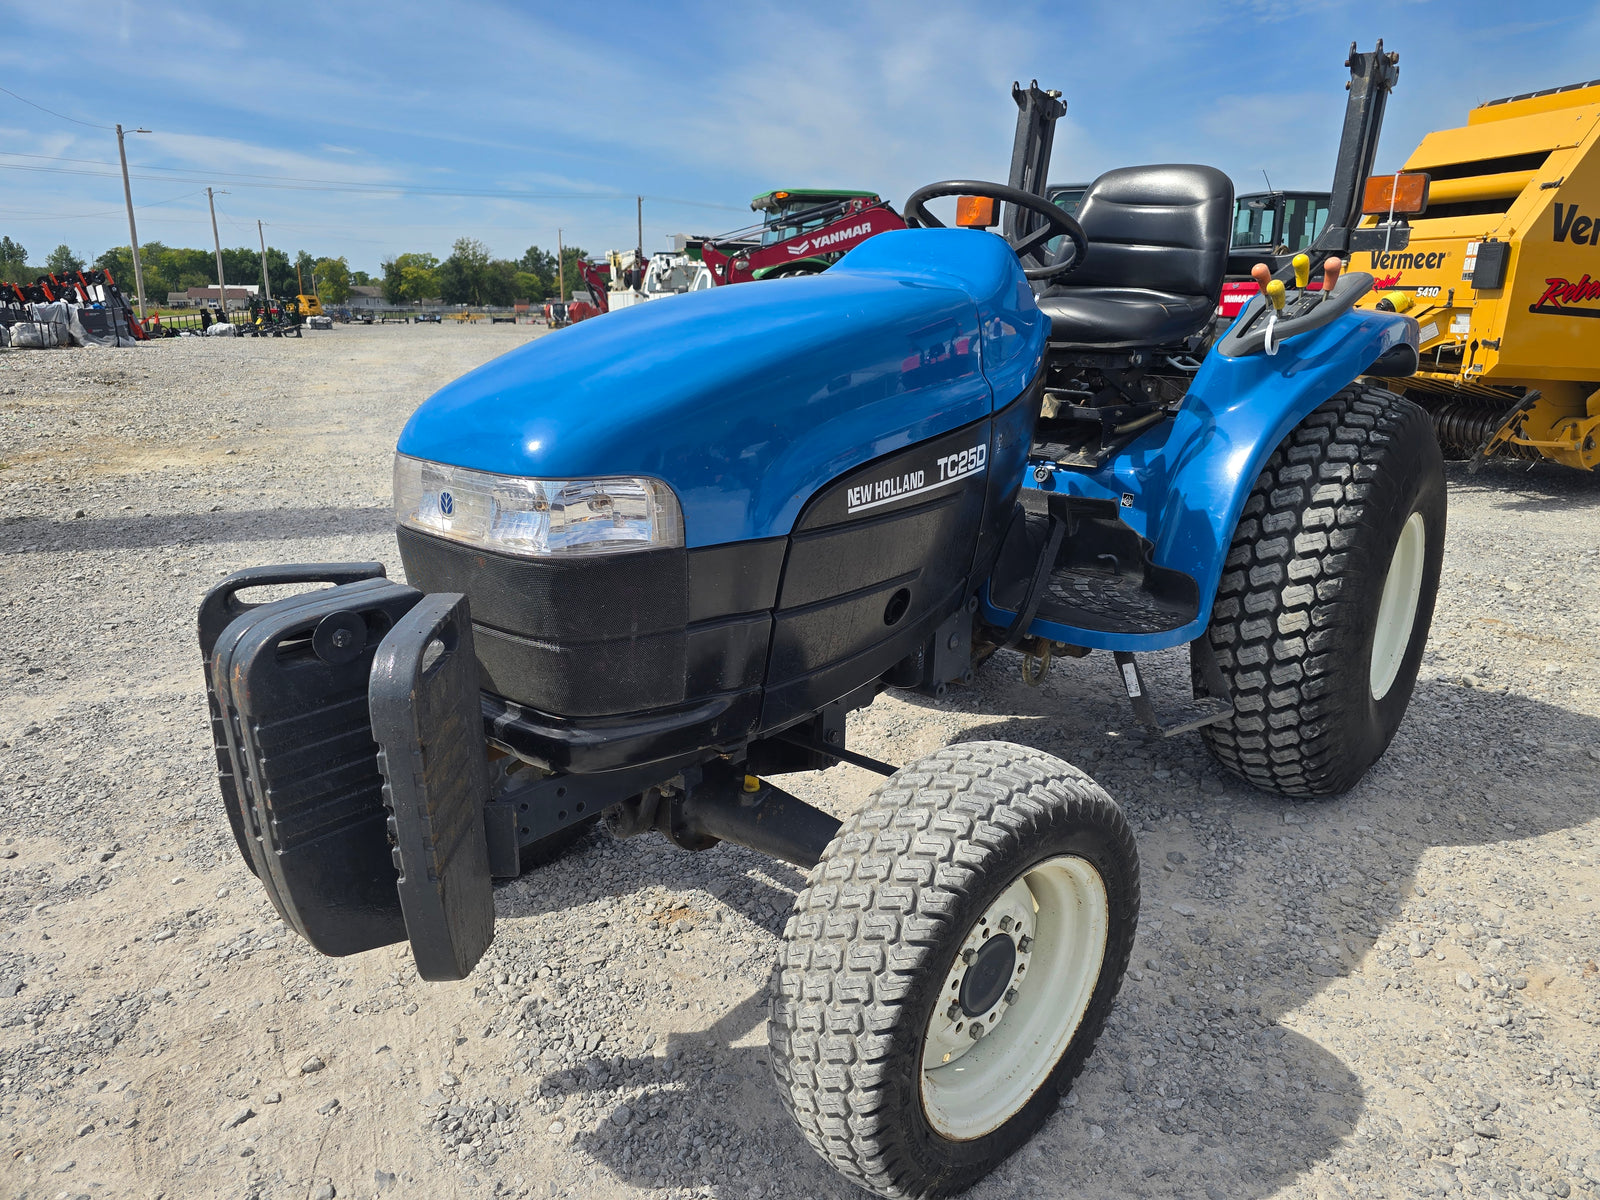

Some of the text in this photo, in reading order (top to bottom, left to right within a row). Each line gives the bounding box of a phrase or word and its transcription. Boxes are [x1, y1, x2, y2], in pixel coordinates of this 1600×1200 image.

[811, 222, 872, 249] YANMAR
[1371, 251, 1446, 270] Vermeer
[1415, 287, 1440, 298] 5410
[1534, 274, 1600, 310] Rebe
[847, 443, 987, 507] NEW HOLLAND TC25D
